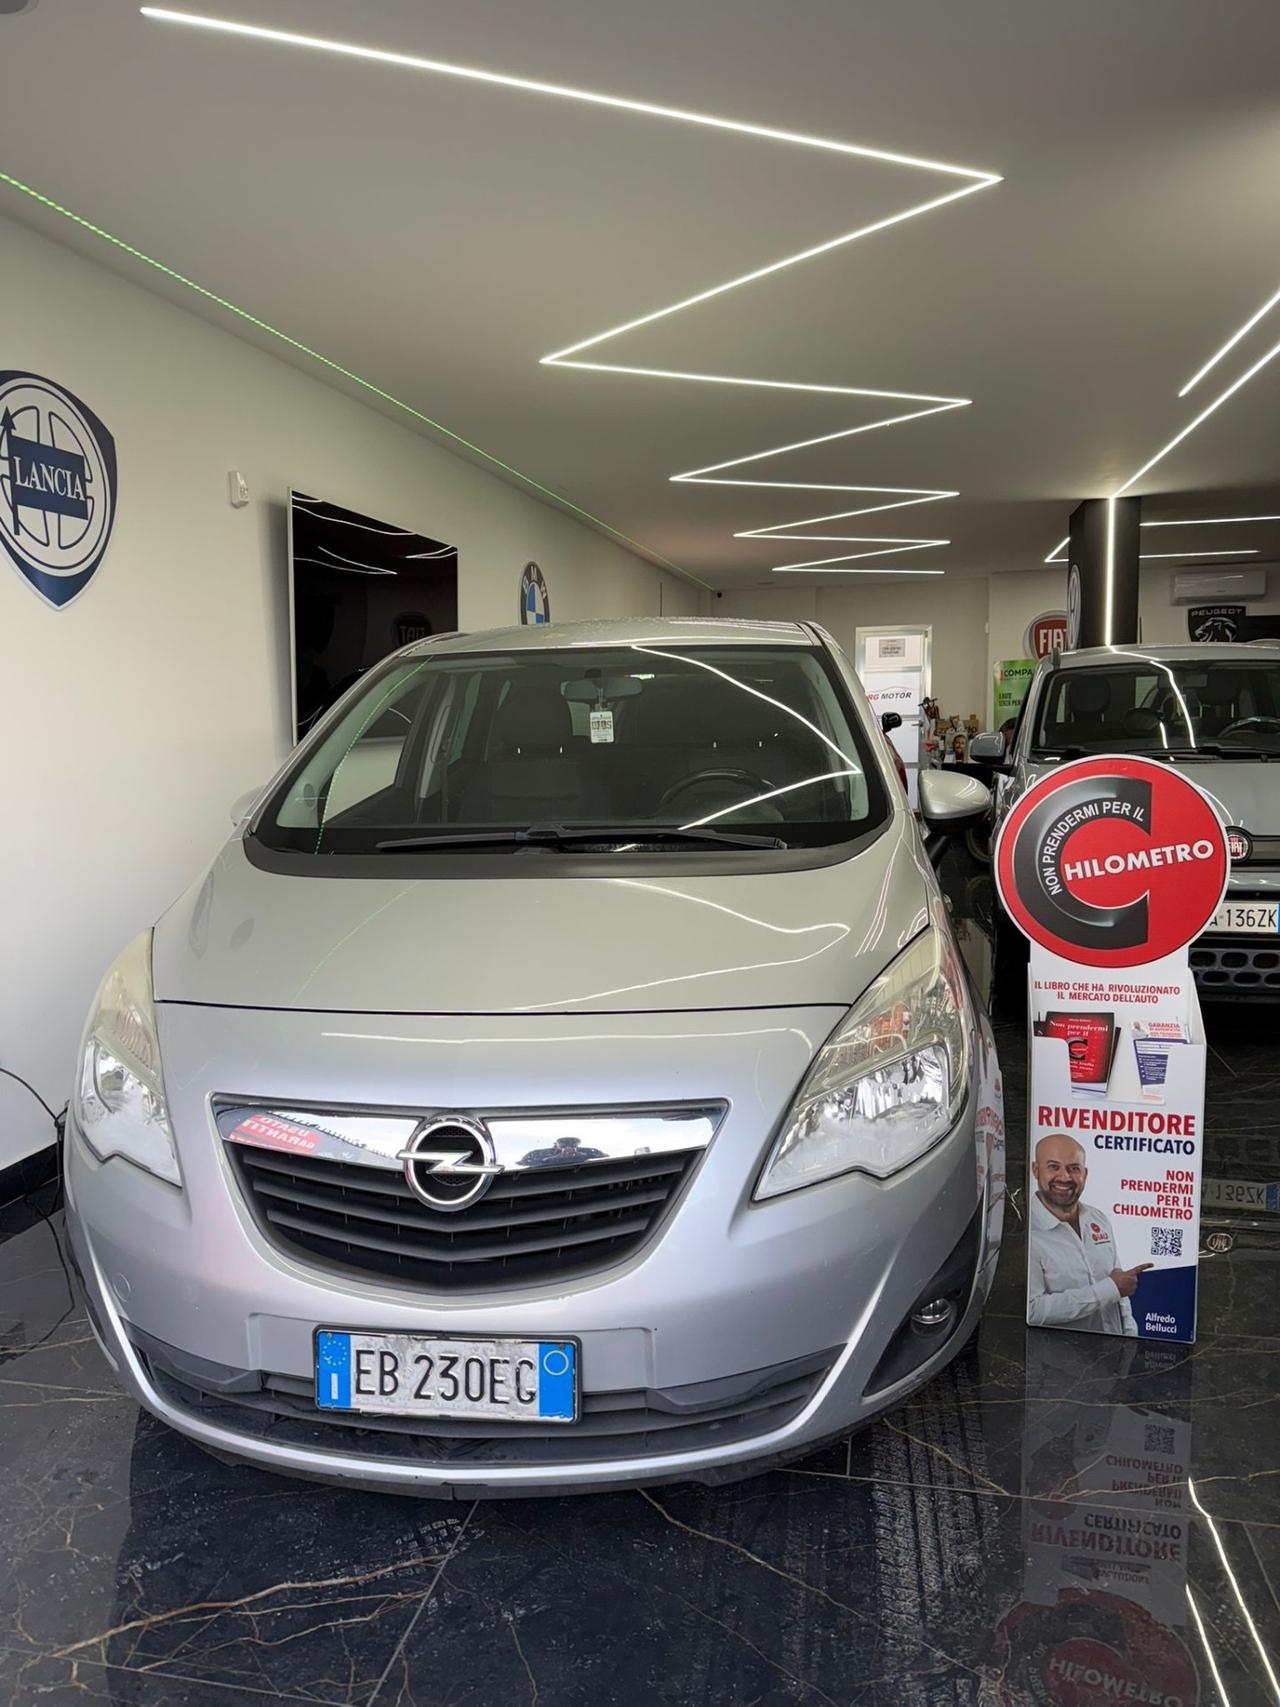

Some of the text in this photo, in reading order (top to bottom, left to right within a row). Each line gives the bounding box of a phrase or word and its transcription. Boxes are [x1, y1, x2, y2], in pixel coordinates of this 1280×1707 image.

[13, 456, 85, 501] LANCIA
[523, 565, 547, 599] BMW
[1191, 608, 1243, 617] PEUGEOT
[881, 691, 912, 699] MOTOR
[1042, 801, 1145, 896] NON PRENDERMI PER IL
[1063, 840, 1214, 881] HILOMETRO
[1226, 909, 1278, 928] 136ZK
[1034, 981, 1181, 995] IL LIBRO CHE HA RIVOLUZIONATO
[1069, 992, 1111, 1002] MERCATO
[1113, 994, 1159, 1004] DELL'AUTO
[1038, 1105, 1196, 1136] RIVENDITORE
[1094, 1134, 1195, 1155] CERTIFICATO
[1166, 1170, 1194, 1183] NON
[1121, 1179, 1194, 1195] PRENDERMI
[1156, 1194, 1194, 1208] PER IL
[1113, 1203, 1193, 1220] CHILOMETRO
[1145, 1312, 1176, 1324] Alfredo
[1145, 1322, 1177, 1334] Bellucci
[355, 1349, 399, 1396] EB
